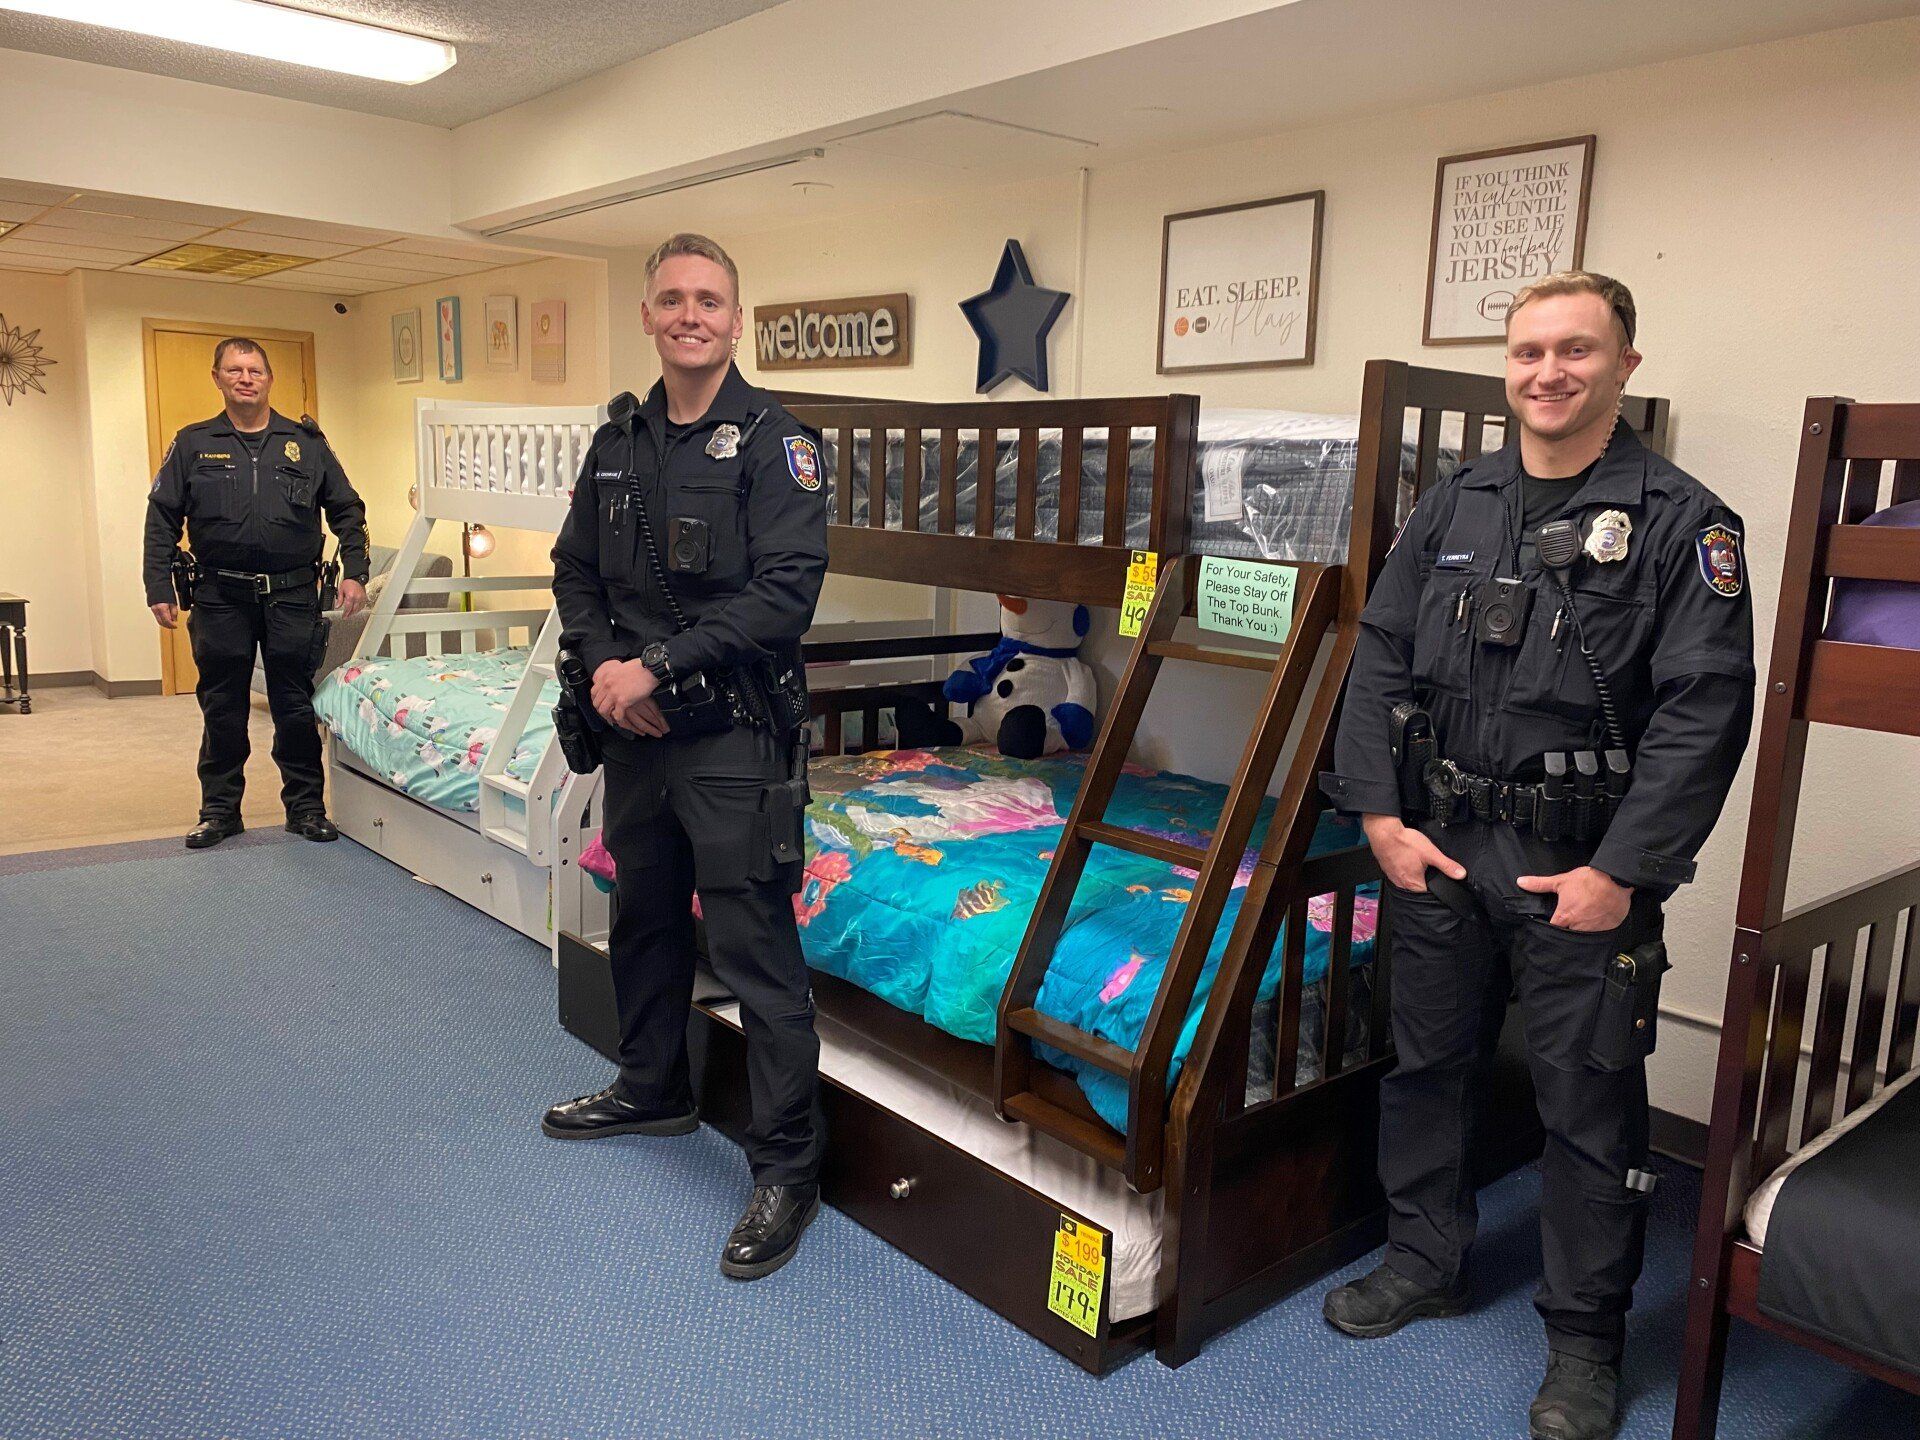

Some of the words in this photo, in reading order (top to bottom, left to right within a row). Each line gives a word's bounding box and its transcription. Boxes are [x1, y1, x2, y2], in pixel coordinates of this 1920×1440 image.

[1455, 176, 1472, 191] IF
[1475, 170, 1509, 188] YOU
[1513, 161, 1569, 183] THINK
[1453, 190, 1479, 206] I'M
[1482, 181, 1521, 205] cute
[1522, 179, 1568, 198] NOW,
[1453, 203, 1500, 222] WAIT
[1506, 196, 1567, 217] UNTIL
[1451, 222, 1488, 240] YOU
[1493, 218, 1529, 236] SEE
[1534, 213, 1565, 231] ME
[1449, 241, 1469, 257] IN
[1474, 238, 1502, 255] MY
[1501, 228, 1563, 264] football
[1445, 251, 1559, 283] JERSEY
[1176, 285, 1220, 308] EAT.
[1226, 275, 1301, 304] SLEEP.
[755, 308, 895, 361] welcome
[1132, 566, 1140, 578] $
[1206, 563, 1223, 575] For
[1227, 566, 1251, 579] Your
[1253, 570, 1291, 588] Safety,
[1126, 591, 1153, 603] SAL
[1127, 584, 1154, 593] HOLID
[1205, 580, 1240, 595] Please
[1243, 585, 1267, 602] Stay
[1270, 589, 1288, 602] Off
[1207, 596, 1226, 609] The
[1230, 599, 1249, 615] Top
[1252, 604, 1283, 619] Bunk.
[1211, 612, 1243, 628] Thank
[1246, 618, 1267, 632] You
[1061, 1233, 1070, 1248] $
[1075, 1240, 1099, 1265] 199
[1055, 1251, 1101, 1281] HOLIDAY
[1055, 1260, 1099, 1293] SALE
